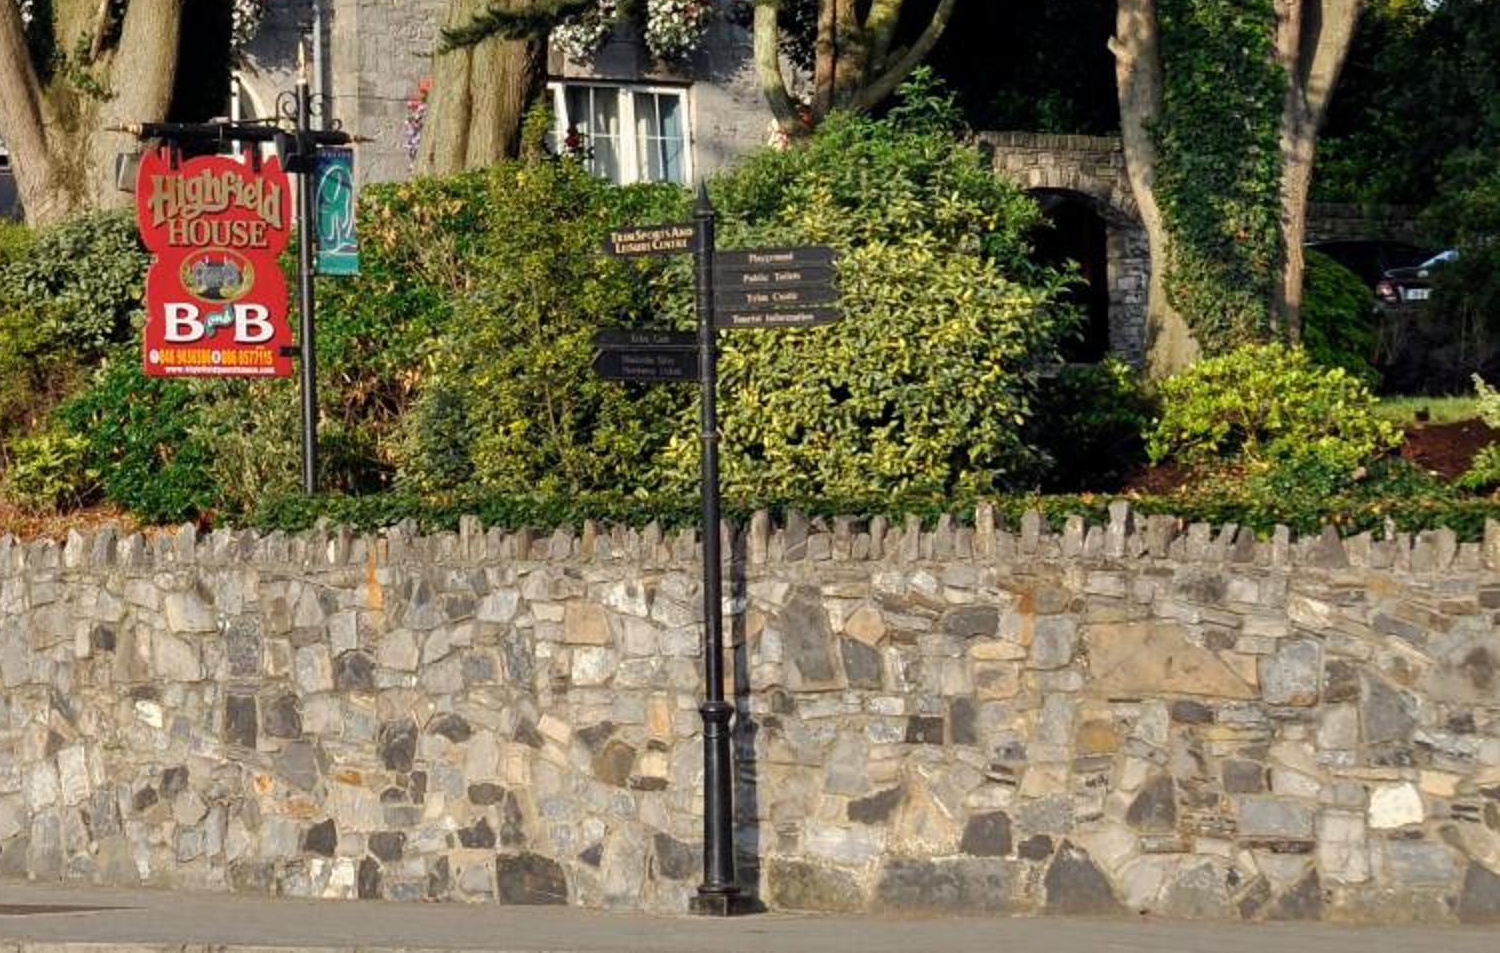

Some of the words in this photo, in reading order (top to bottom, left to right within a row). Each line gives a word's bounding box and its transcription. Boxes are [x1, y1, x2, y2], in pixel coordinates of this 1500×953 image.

[149, 168, 282, 229] Highfield
[168, 219, 268, 247] HOUSE
[164, 303, 205, 343] B
[234, 303, 275, 343] B
